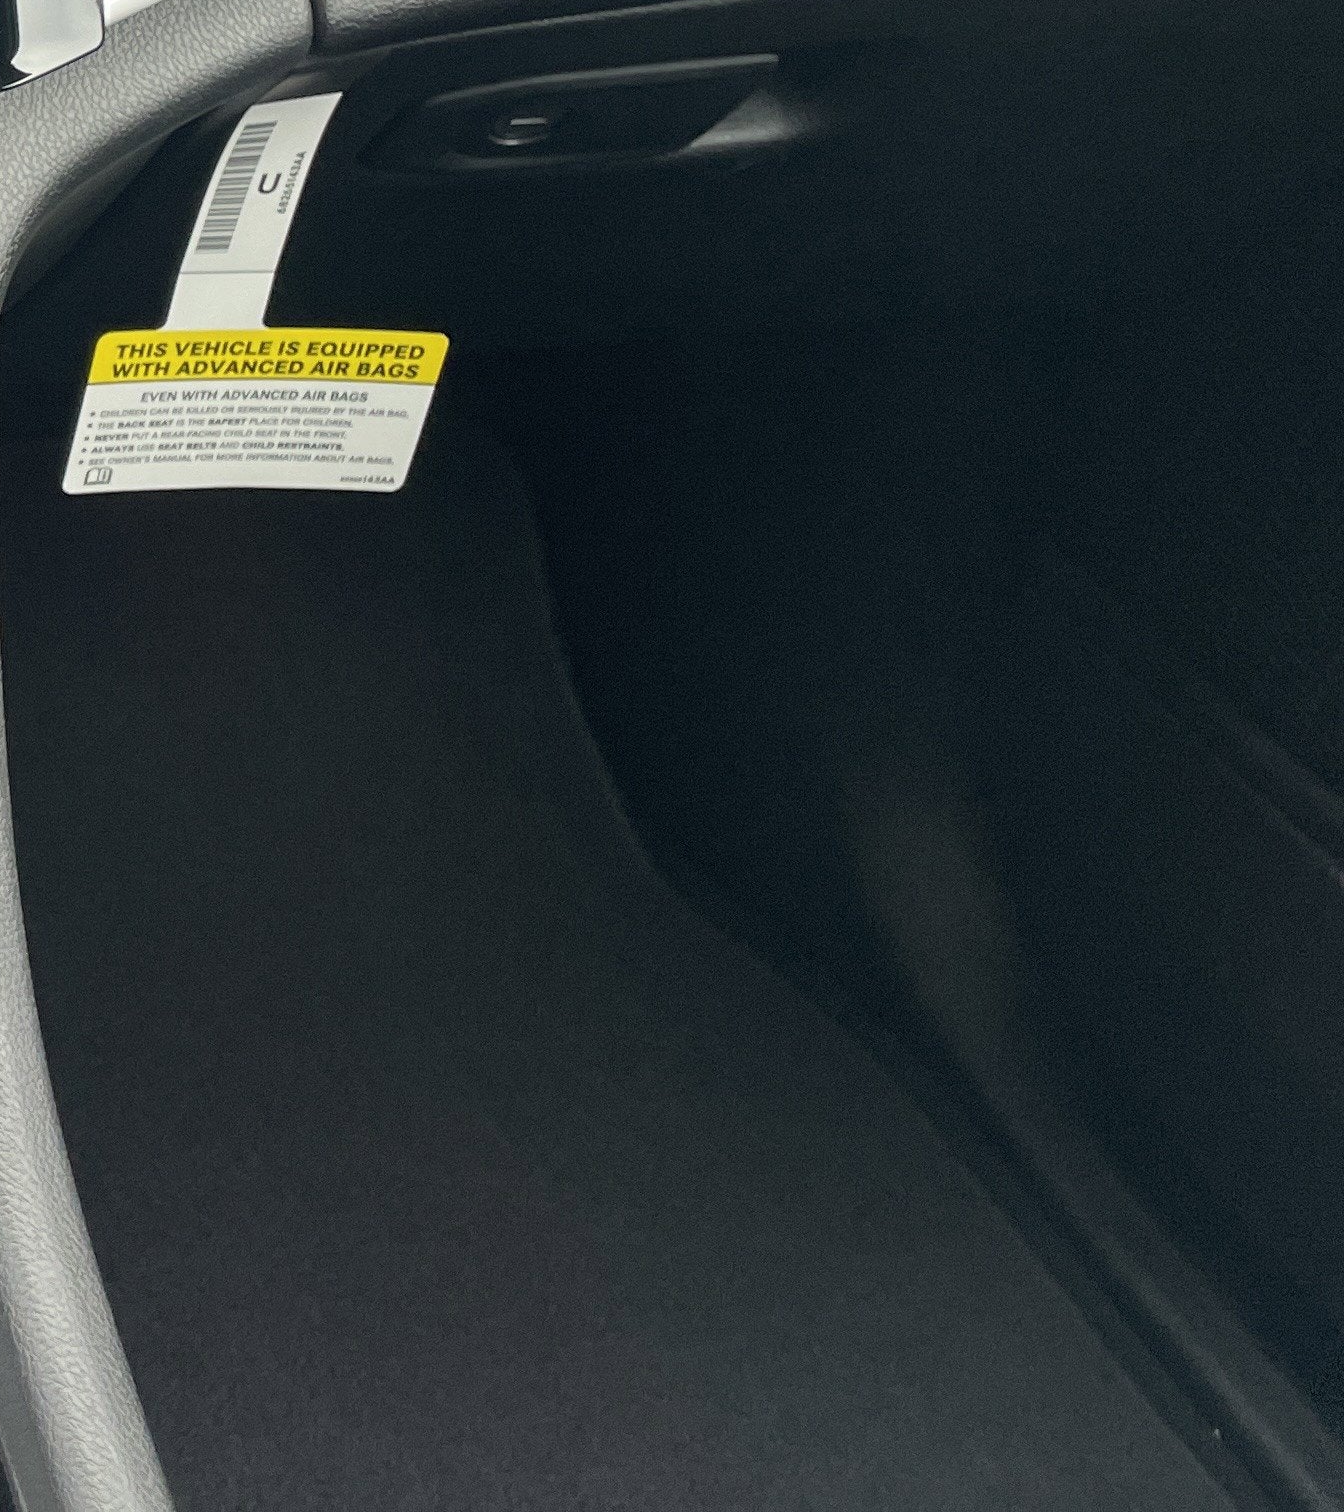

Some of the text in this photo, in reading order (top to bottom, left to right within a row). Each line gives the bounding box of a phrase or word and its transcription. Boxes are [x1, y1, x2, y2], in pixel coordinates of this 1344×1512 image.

[258, 172, 282, 194] U
[116, 341, 425, 359] THIS VEHICLE IS EQUIPPED
[112, 360, 420, 378] WITH ADVANCED AIR BAGS
[140, 389, 369, 403] EVEN WITH ADVANCED AIR BAGS
